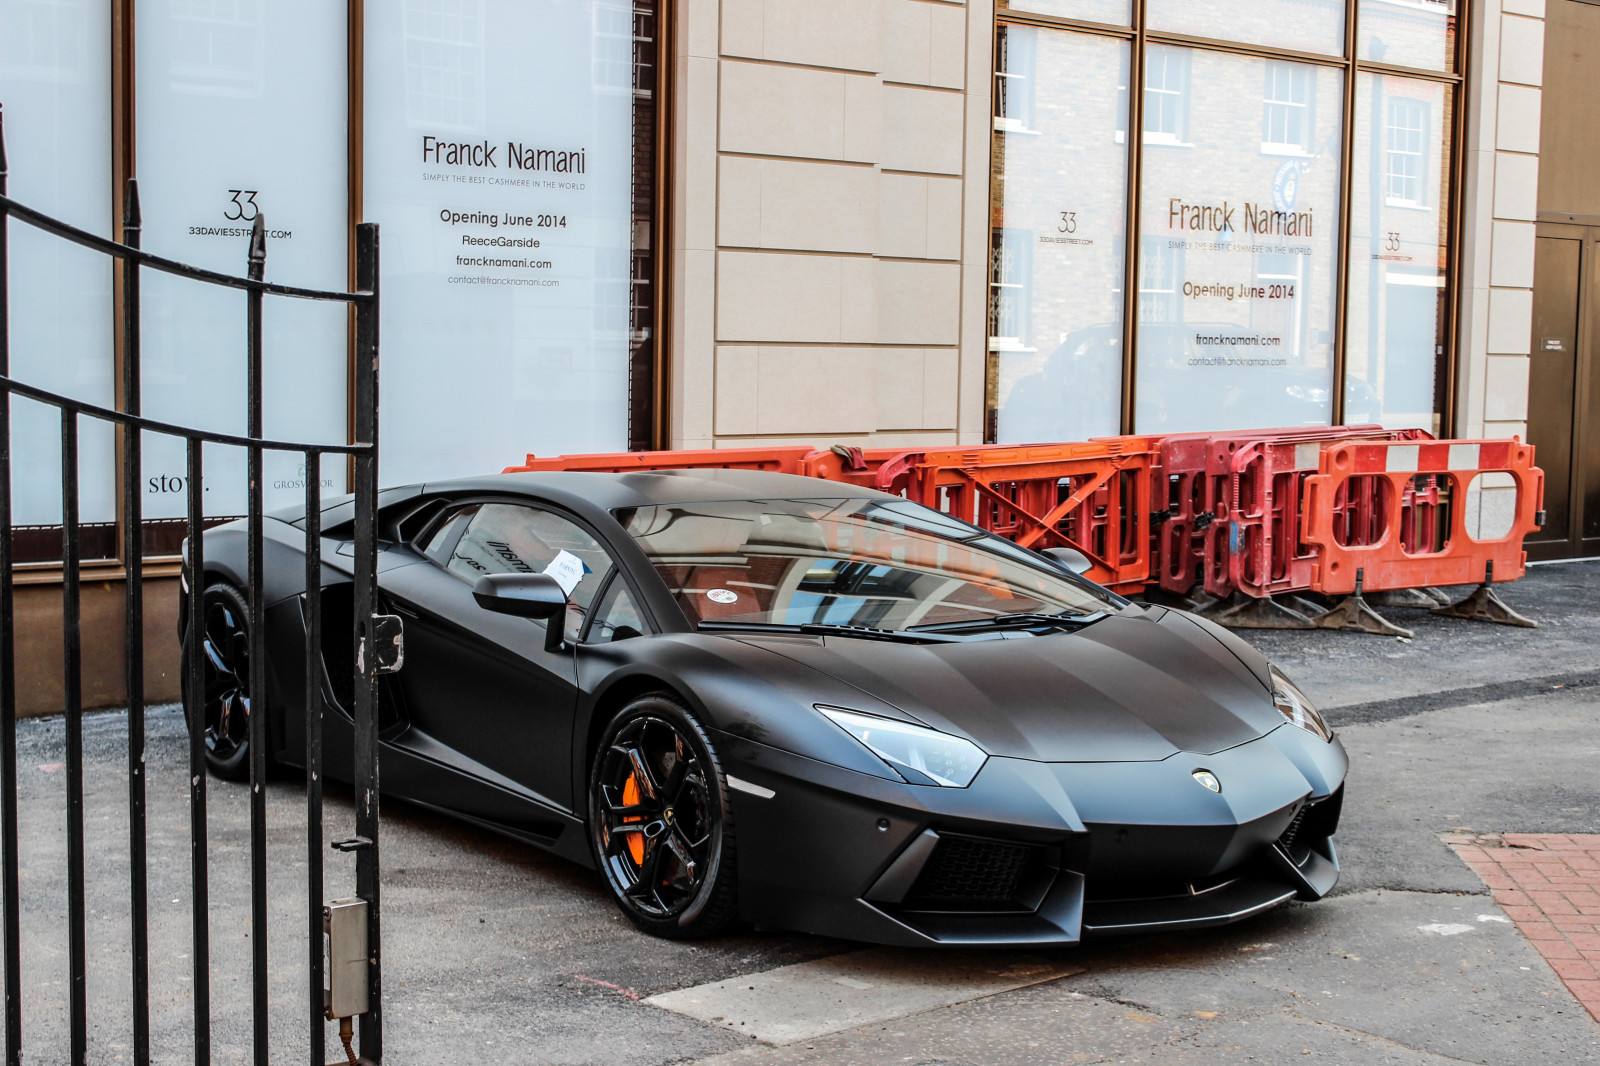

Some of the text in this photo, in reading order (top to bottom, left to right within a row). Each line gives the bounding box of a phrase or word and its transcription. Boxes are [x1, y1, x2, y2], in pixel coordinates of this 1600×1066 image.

[423, 136, 585, 174] Franck Namani
[423, 173, 450, 182] SIMPLY
[452, 175, 466, 183] THE
[468, 176, 486, 184] BEST
[488, 177, 530, 187] CASHMERE
[543, 180, 556, 189] THE
[558, 182, 586, 190] WORLD
[224, 190, 258, 221] 33
[440, 209, 567, 228] Opening June 2014
[1057, 211, 1076, 233] 33
[1169, 198, 1313, 237] Franck Namani
[189, 227, 292, 239] 33DAVIESSTRT.COM
[462, 235, 540, 248] ReeceGarside
[1168, 241, 1192, 250] SIMPLY
[1209, 243, 1225, 251] BEST
[1288, 247, 1312, 256] WORLD
[1385, 232, 1400, 251] 33
[456, 255, 552, 269] francknamani.com
[448, 275, 560, 287] contact@francknamani.com
[1183, 281, 1294, 300] Opening June 2014
[1196, 334, 1280, 346] francknamani.com
[1188, 357, 1287, 367] contact@francknamani.com
[273, 479, 334, 490] GROSVOR
